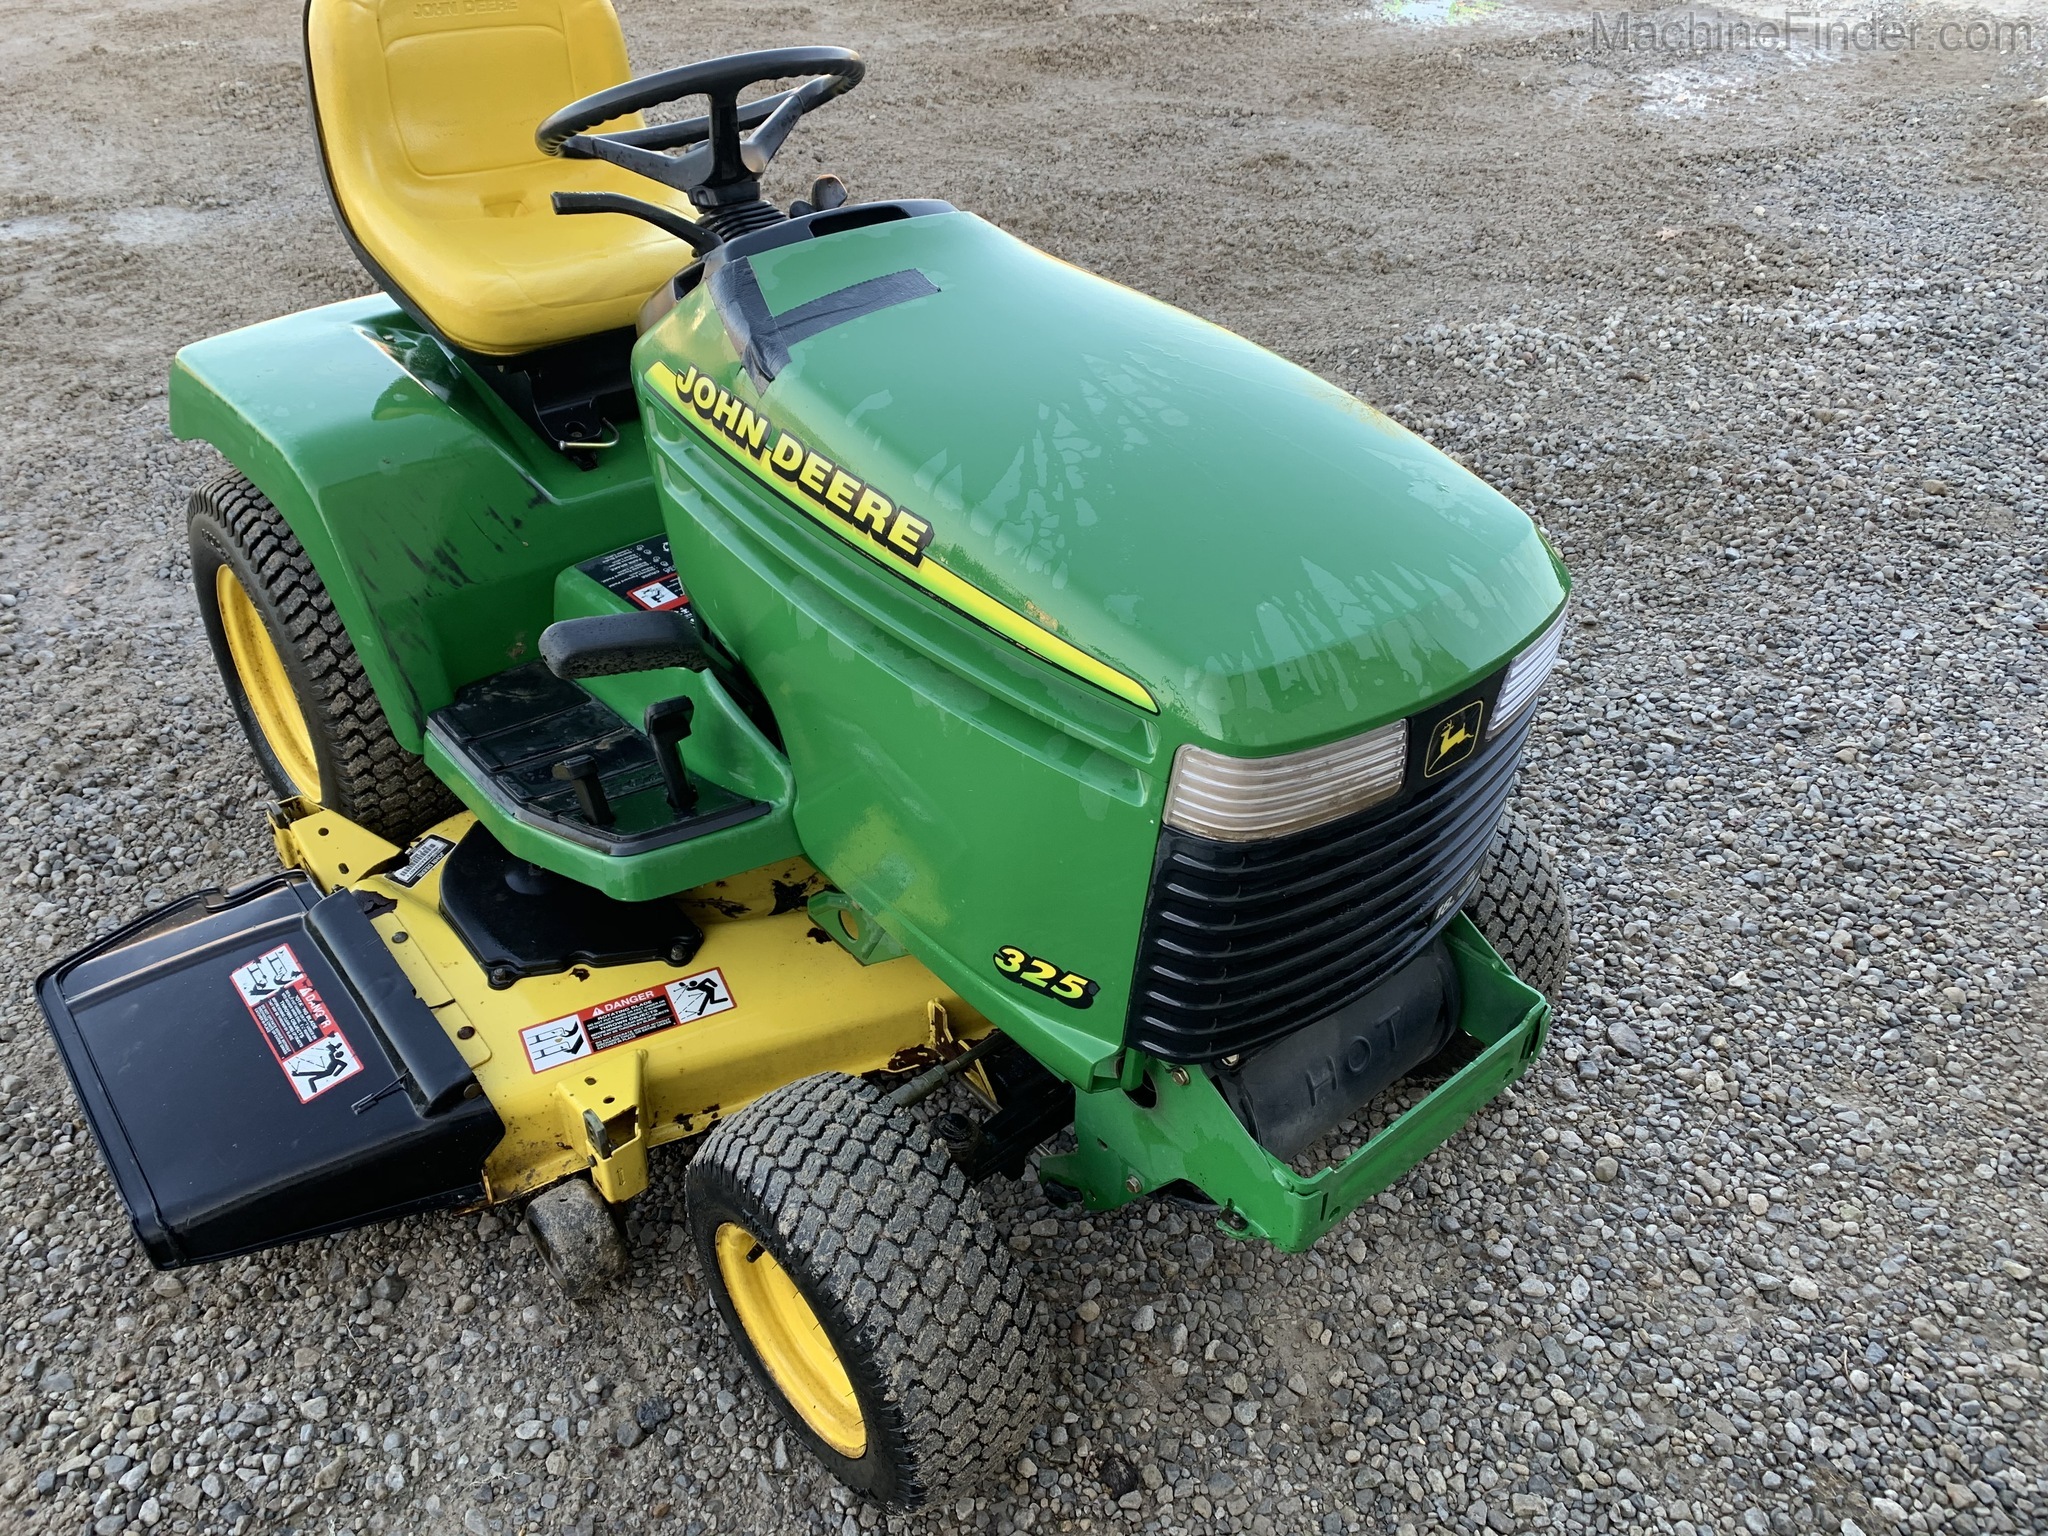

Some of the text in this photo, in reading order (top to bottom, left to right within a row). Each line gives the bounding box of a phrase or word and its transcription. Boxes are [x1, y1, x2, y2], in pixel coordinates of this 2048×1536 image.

[675, 363, 932, 565] JOHN DEERE
[604, 990, 654, 1011] DANGER
[993, 946, 1097, 1006] 325
[304, 993, 332, 1028] DANGR
[1305, 1005, 1400, 1108] HOT
